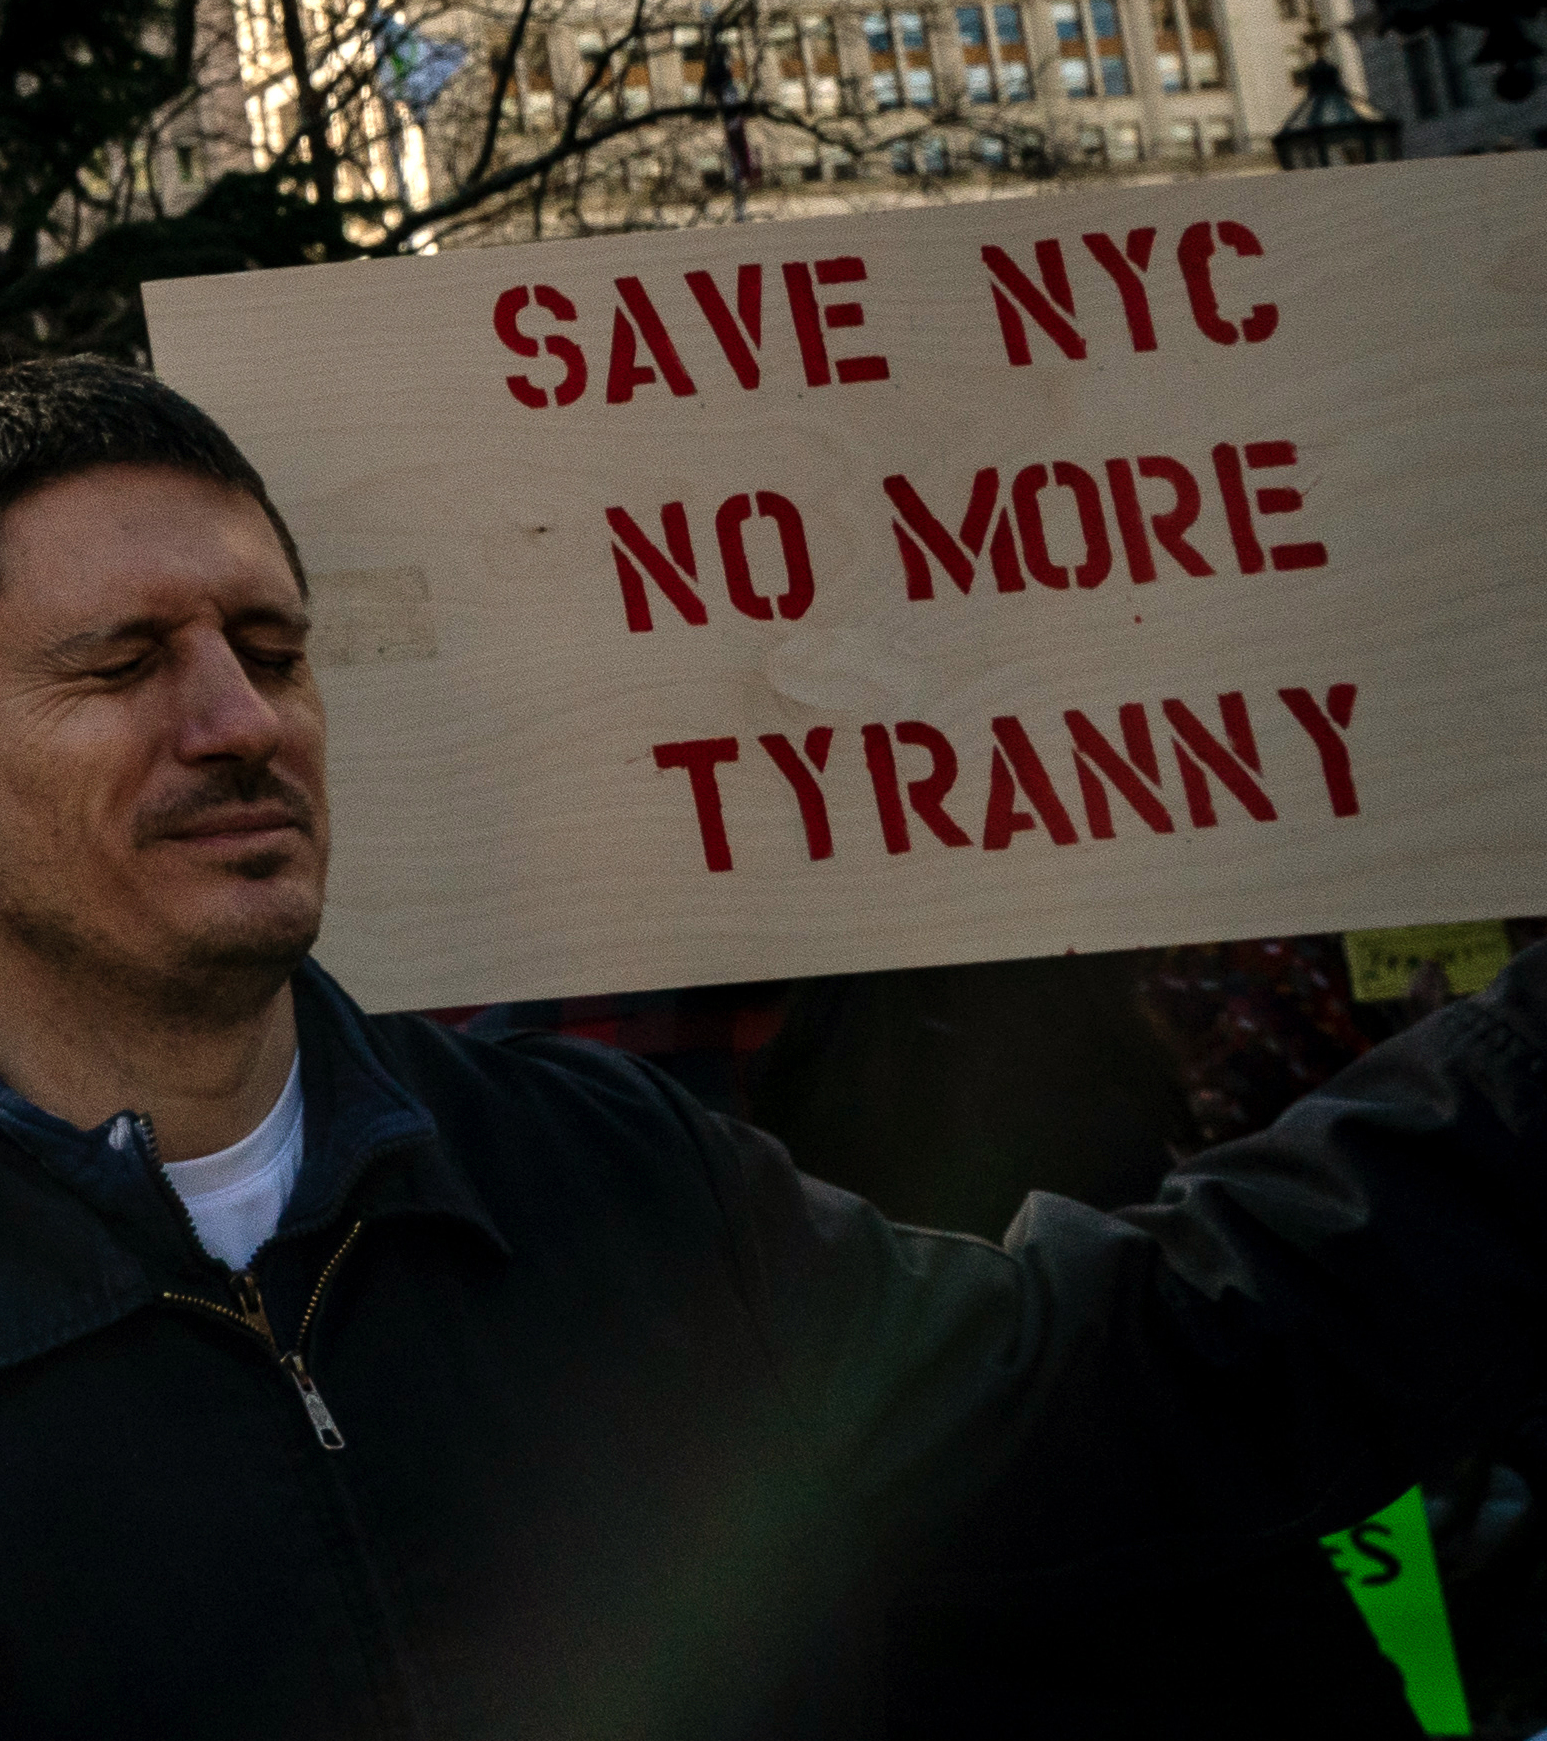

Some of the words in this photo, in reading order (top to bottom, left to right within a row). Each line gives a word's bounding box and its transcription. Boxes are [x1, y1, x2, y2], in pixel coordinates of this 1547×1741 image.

[491, 255, 890, 411] SAVE
[980, 219, 1280, 369] NYC
[604, 489, 817, 634] NO
[881, 439, 1329, 603] MORE
[652, 682, 1361, 874] TYRANNY
